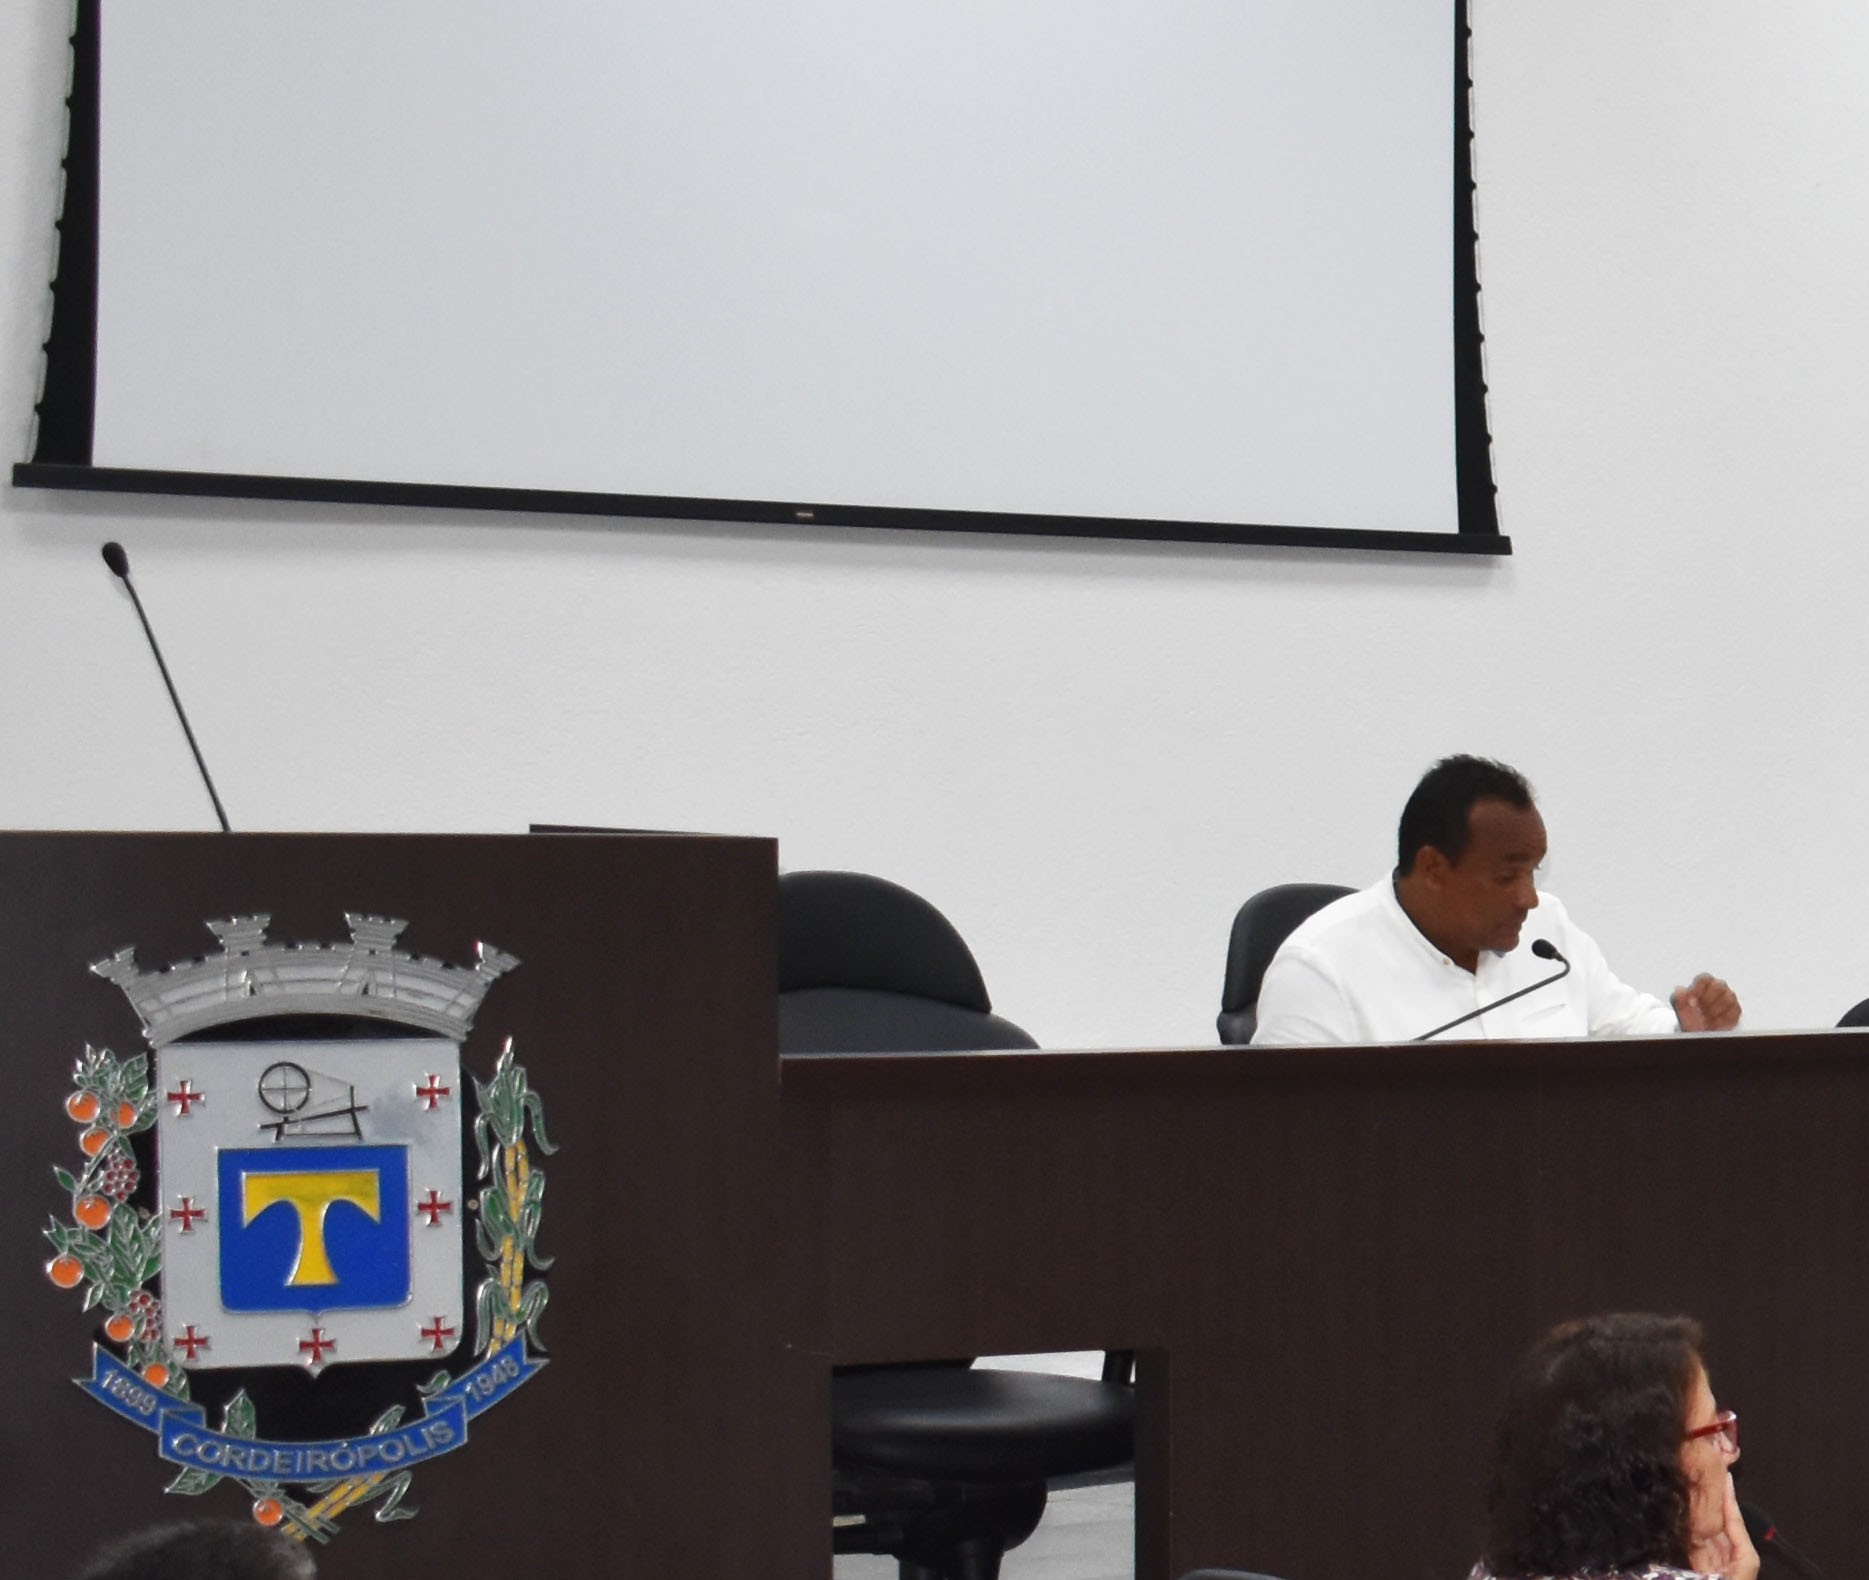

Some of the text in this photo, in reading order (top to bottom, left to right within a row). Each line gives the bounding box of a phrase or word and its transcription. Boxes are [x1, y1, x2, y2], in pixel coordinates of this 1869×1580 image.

[101, 1367, 157, 1416] 1899
[465, 1355, 519, 1402] 1948
[171, 1420, 455, 1474] CORDEIRÓPOLIS
